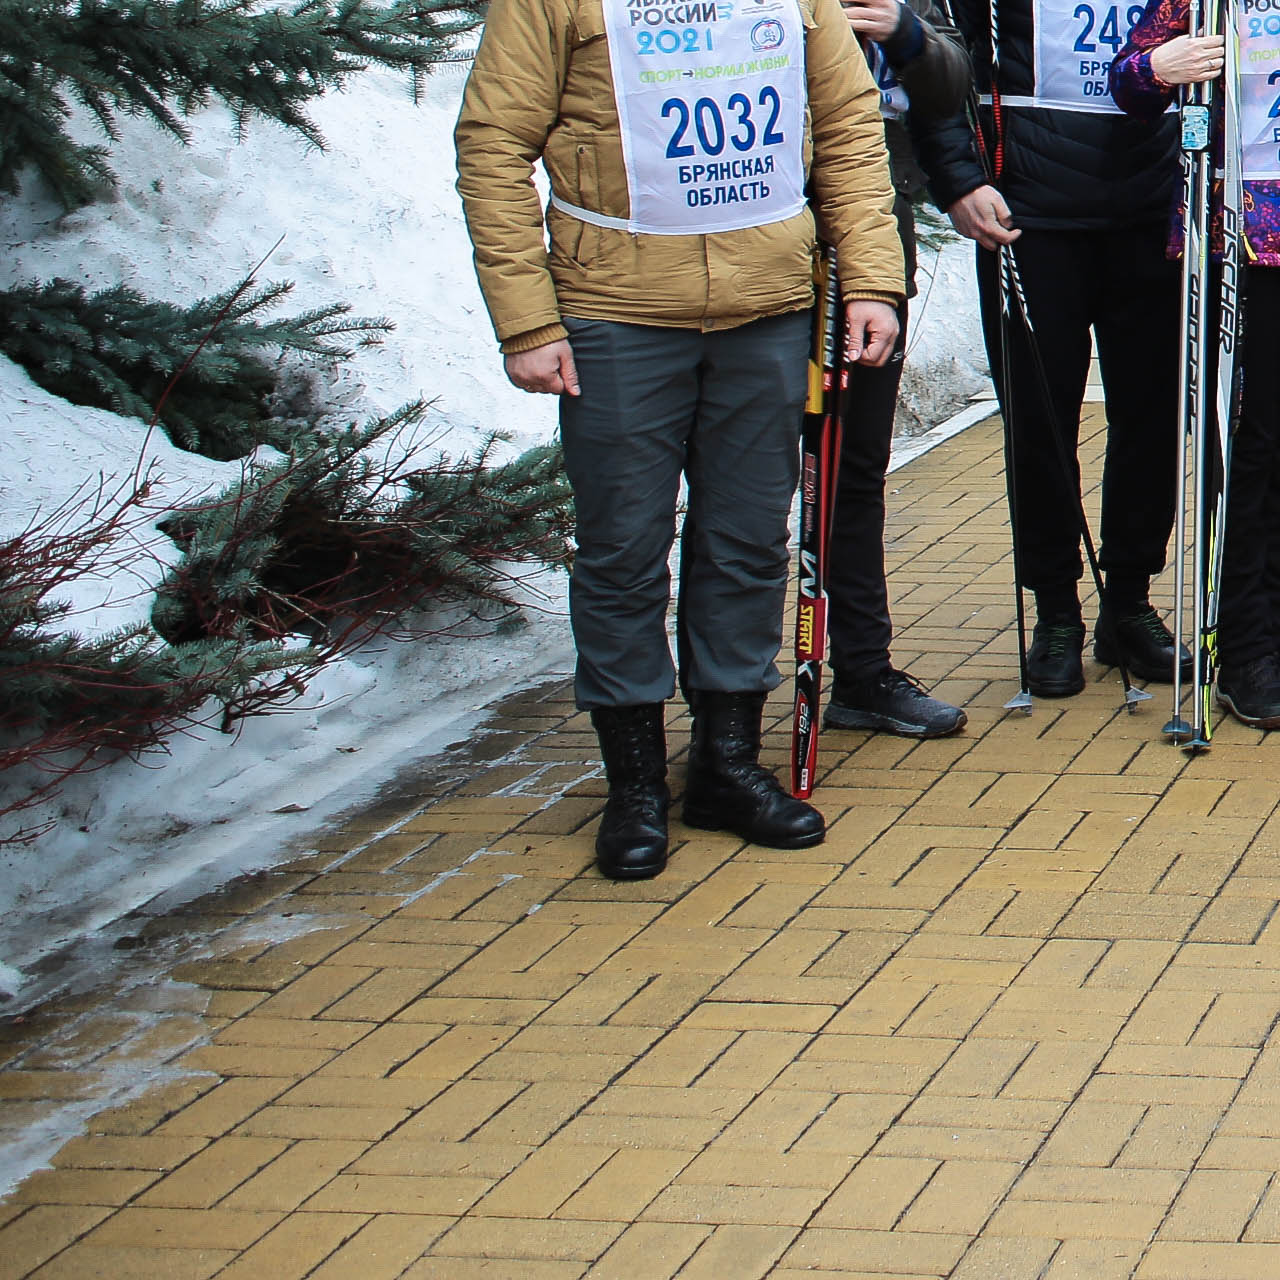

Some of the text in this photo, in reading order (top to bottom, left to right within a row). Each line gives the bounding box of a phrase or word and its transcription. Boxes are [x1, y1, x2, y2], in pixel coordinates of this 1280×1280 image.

[630, 2, 718, 27] РОССИИ
[1073, 4, 1143, 53] 248
[637, 29, 713, 55] 2021
[661, 85, 784, 160] 2032
[679, 155, 774, 184] БРЯНСКАЯ
[687, 182, 770, 207] ОБЛАСТЬ
[1219, 205, 1238, 355] FISCHER
[799, 605, 814, 655] START
[798, 703, 808, 735] 192
